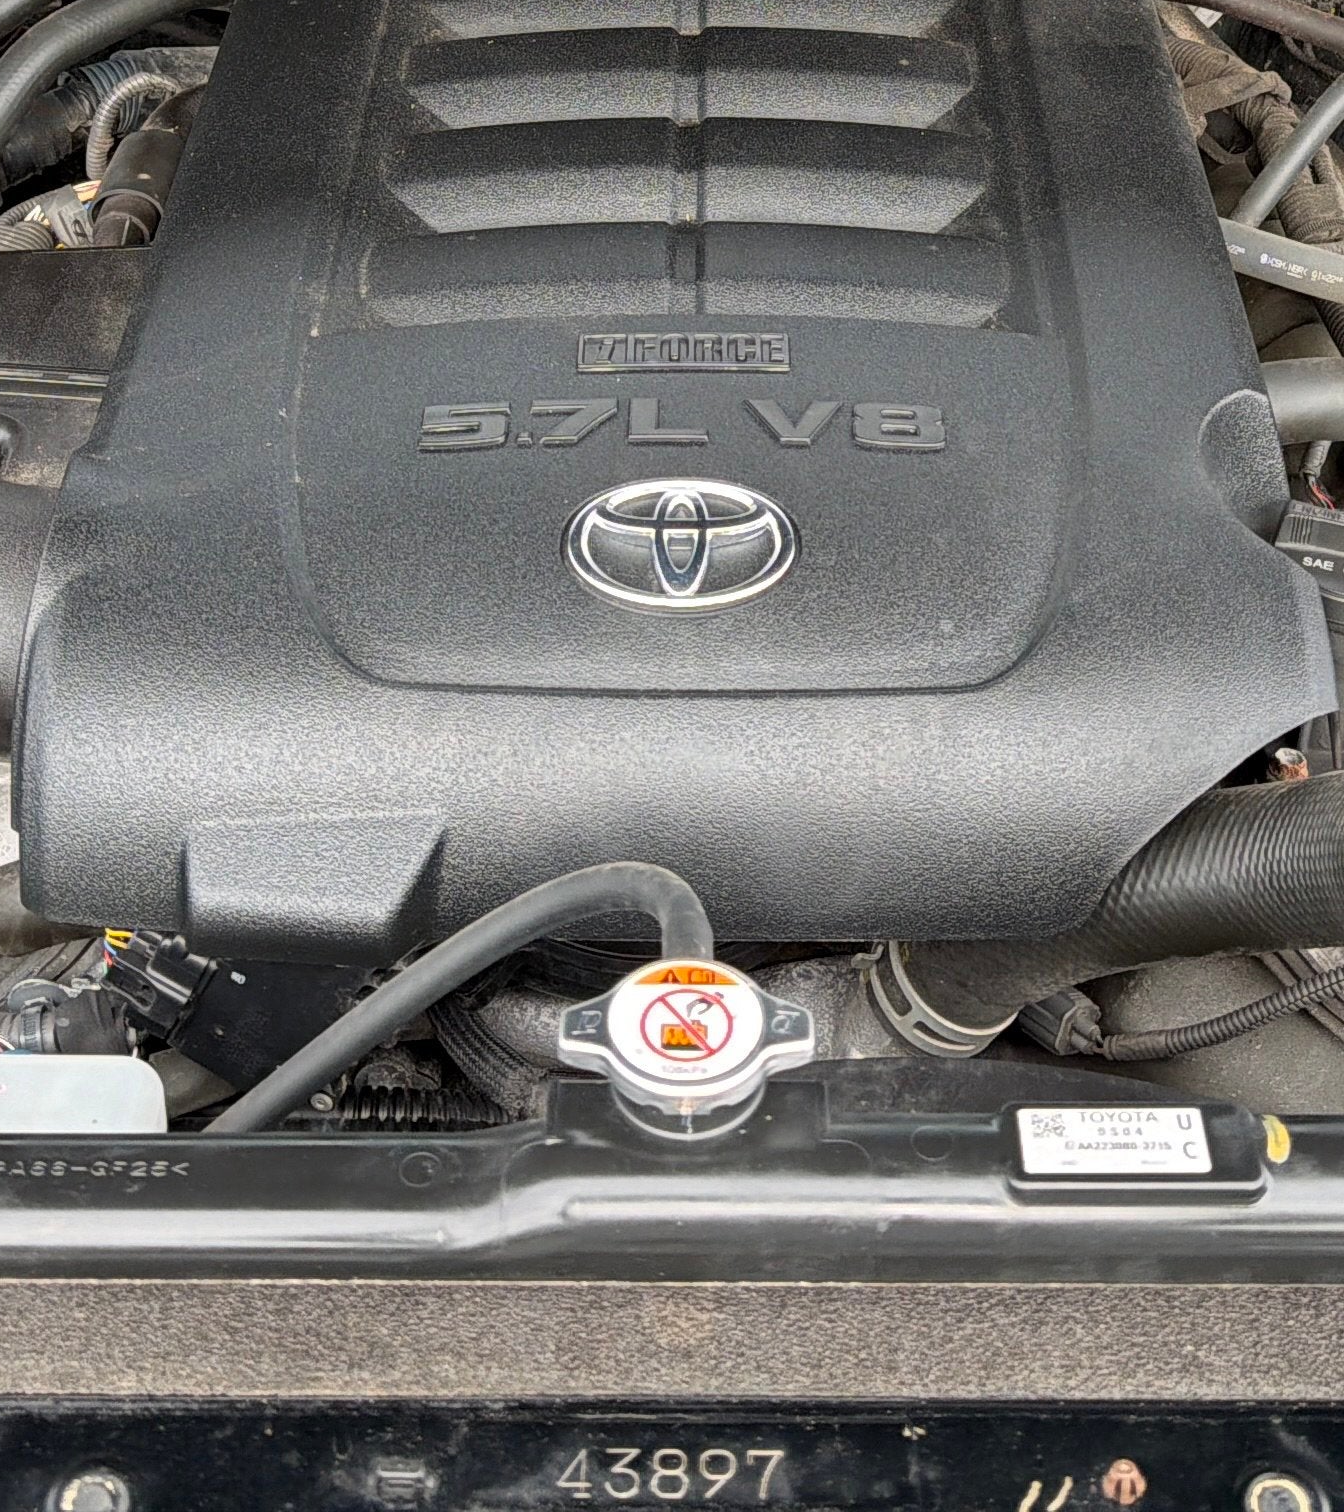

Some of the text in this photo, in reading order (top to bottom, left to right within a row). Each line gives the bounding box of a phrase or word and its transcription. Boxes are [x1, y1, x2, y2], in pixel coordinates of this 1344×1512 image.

[417, 397, 948, 452] 5.7L V8
[1302, 556, 1334, 571] SAE
[1080, 1111, 1159, 1123] TOYOTA
[556, 1447, 786, 1501] 43897
